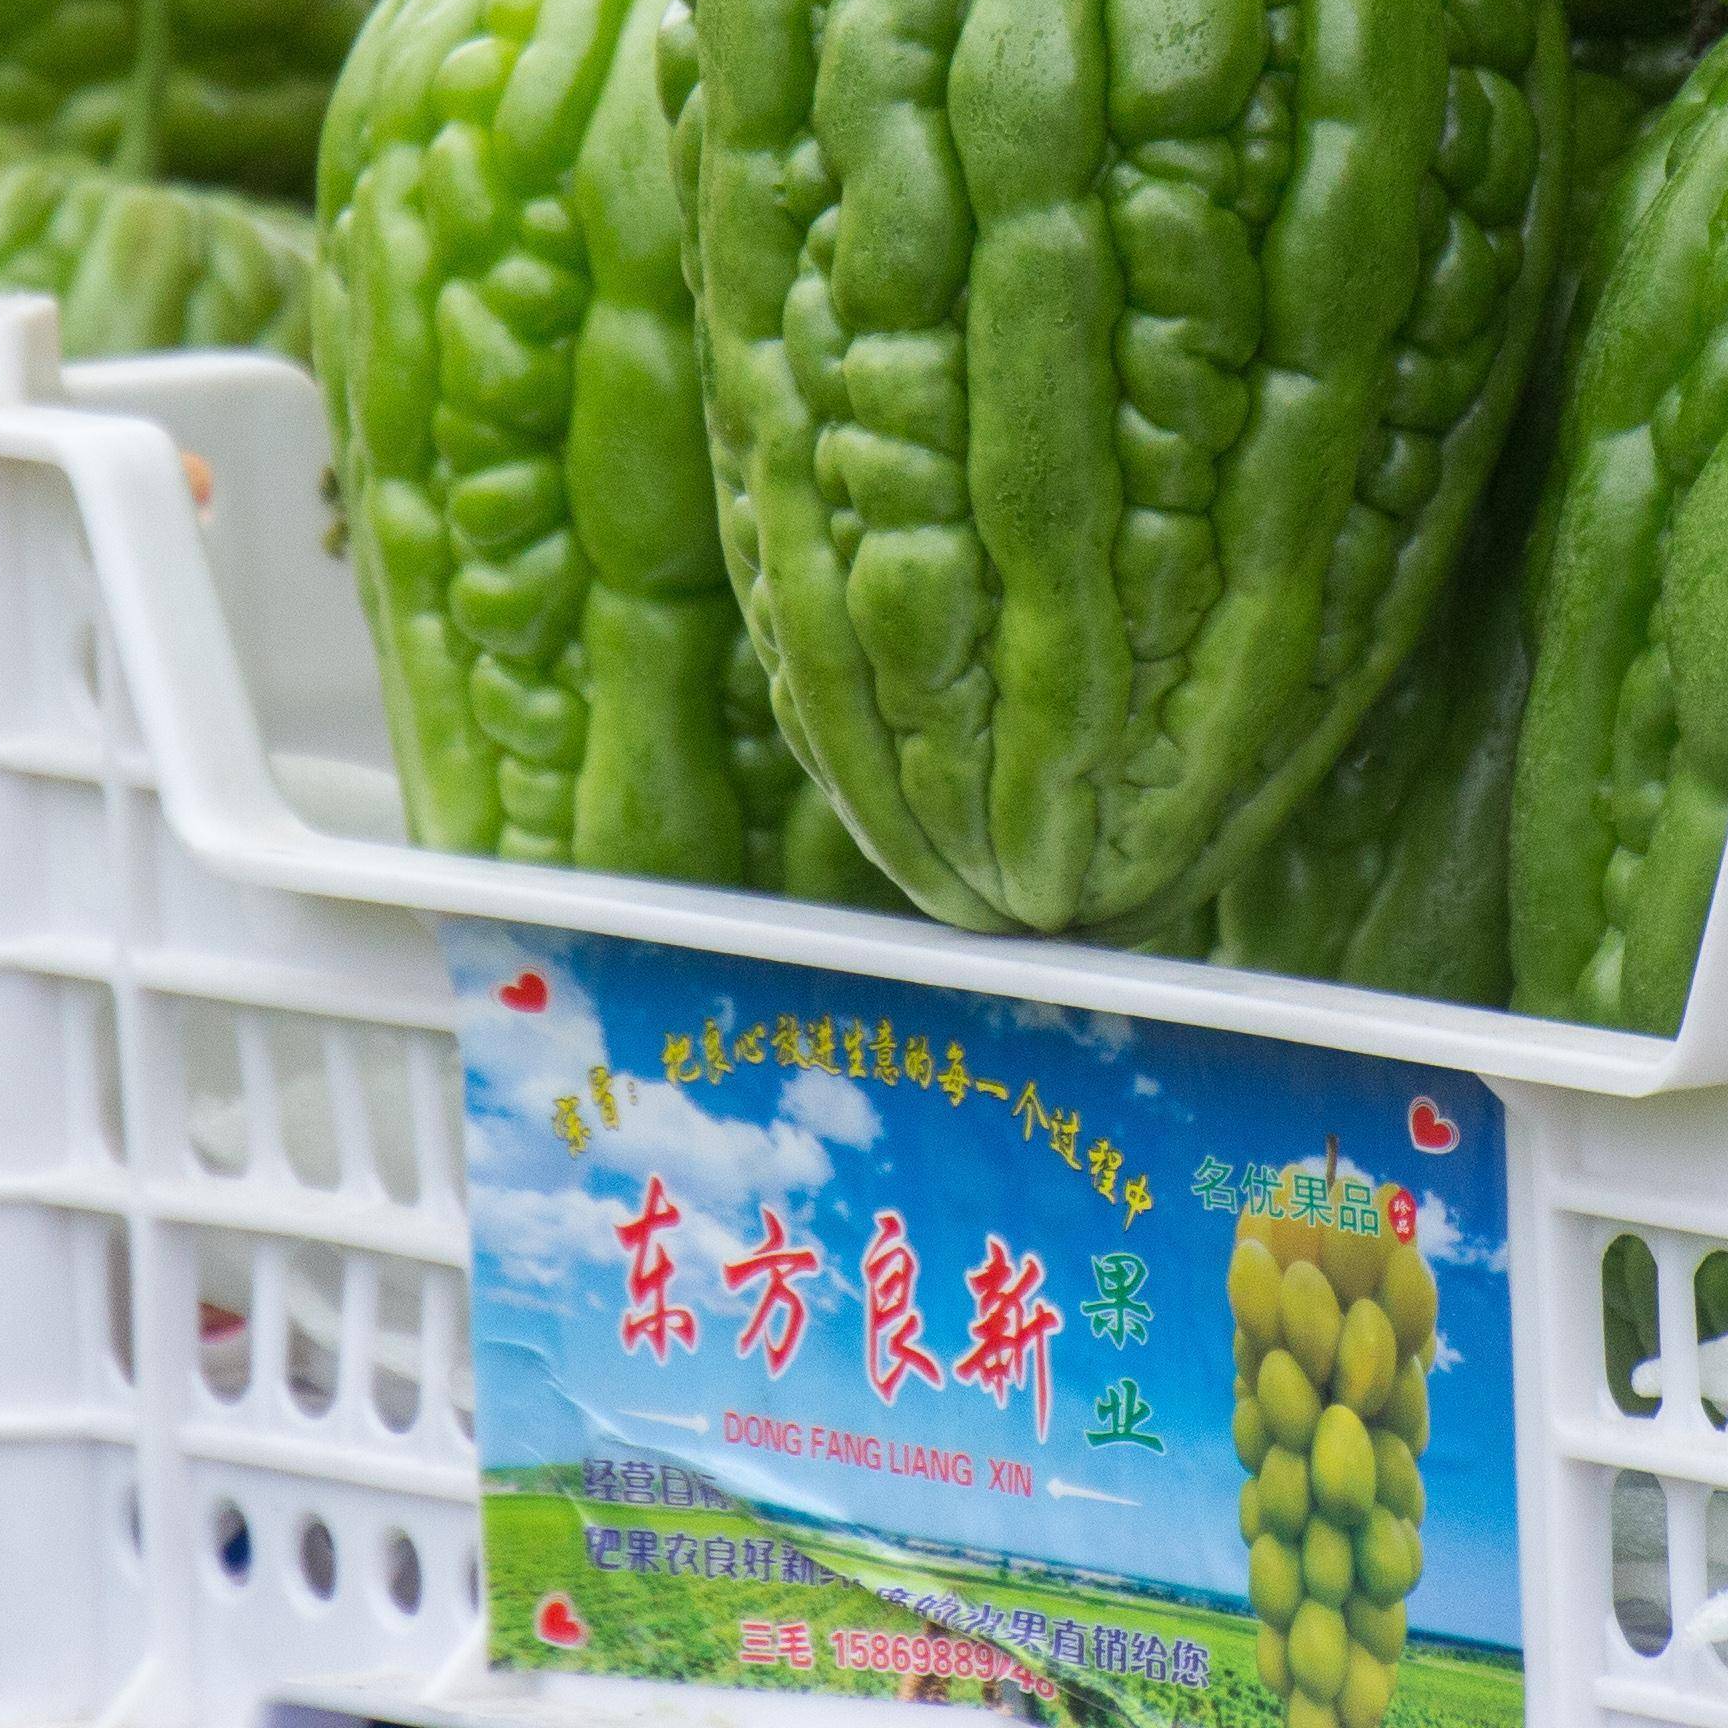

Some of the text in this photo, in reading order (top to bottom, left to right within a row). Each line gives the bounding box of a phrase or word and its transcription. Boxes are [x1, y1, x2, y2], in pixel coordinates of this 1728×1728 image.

[1191, 1154, 1381, 1238] 名优果品
[1080, 1252, 1166, 1456] 果业
[723, 1410, 1034, 1499] DONG FANG LIANG XIN
[740, 1621, 814, 1671] 三毛
